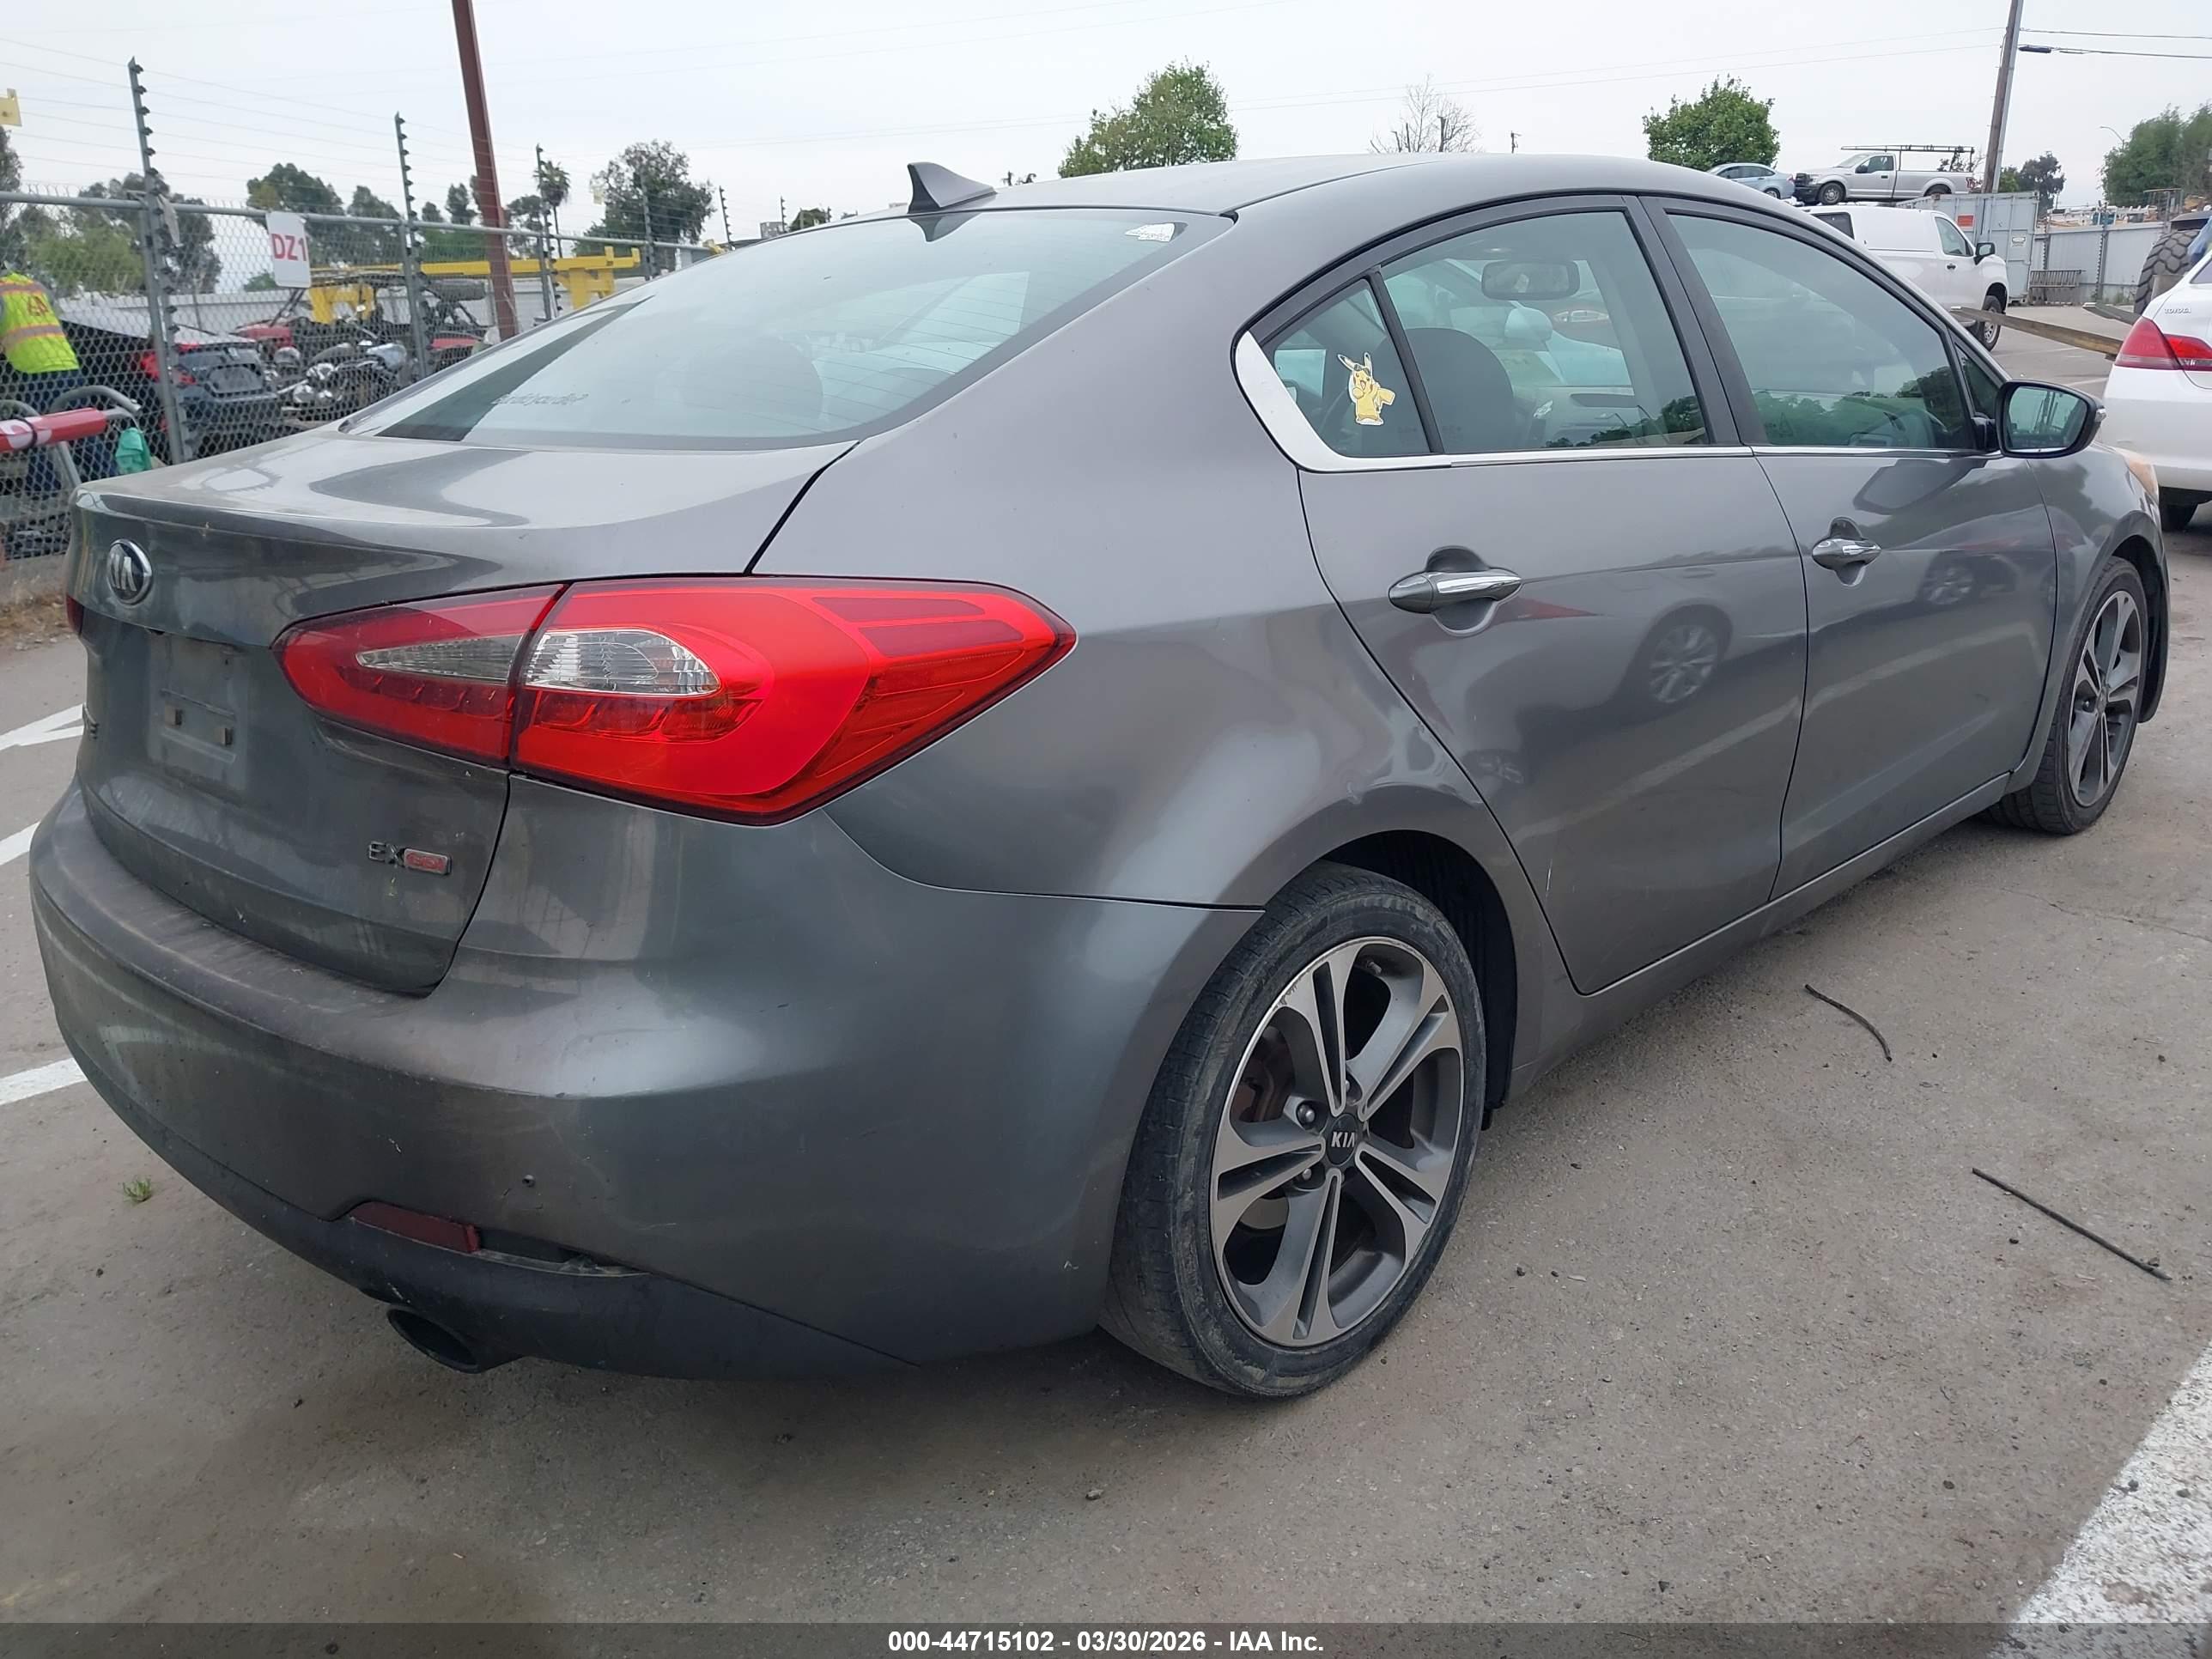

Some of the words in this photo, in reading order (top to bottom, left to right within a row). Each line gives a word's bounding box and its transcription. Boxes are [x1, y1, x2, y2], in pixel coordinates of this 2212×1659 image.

[271, 233, 307, 262] DZ1
[368, 841, 401, 865] EX
[1331, 1131, 1355, 1148] KIA
